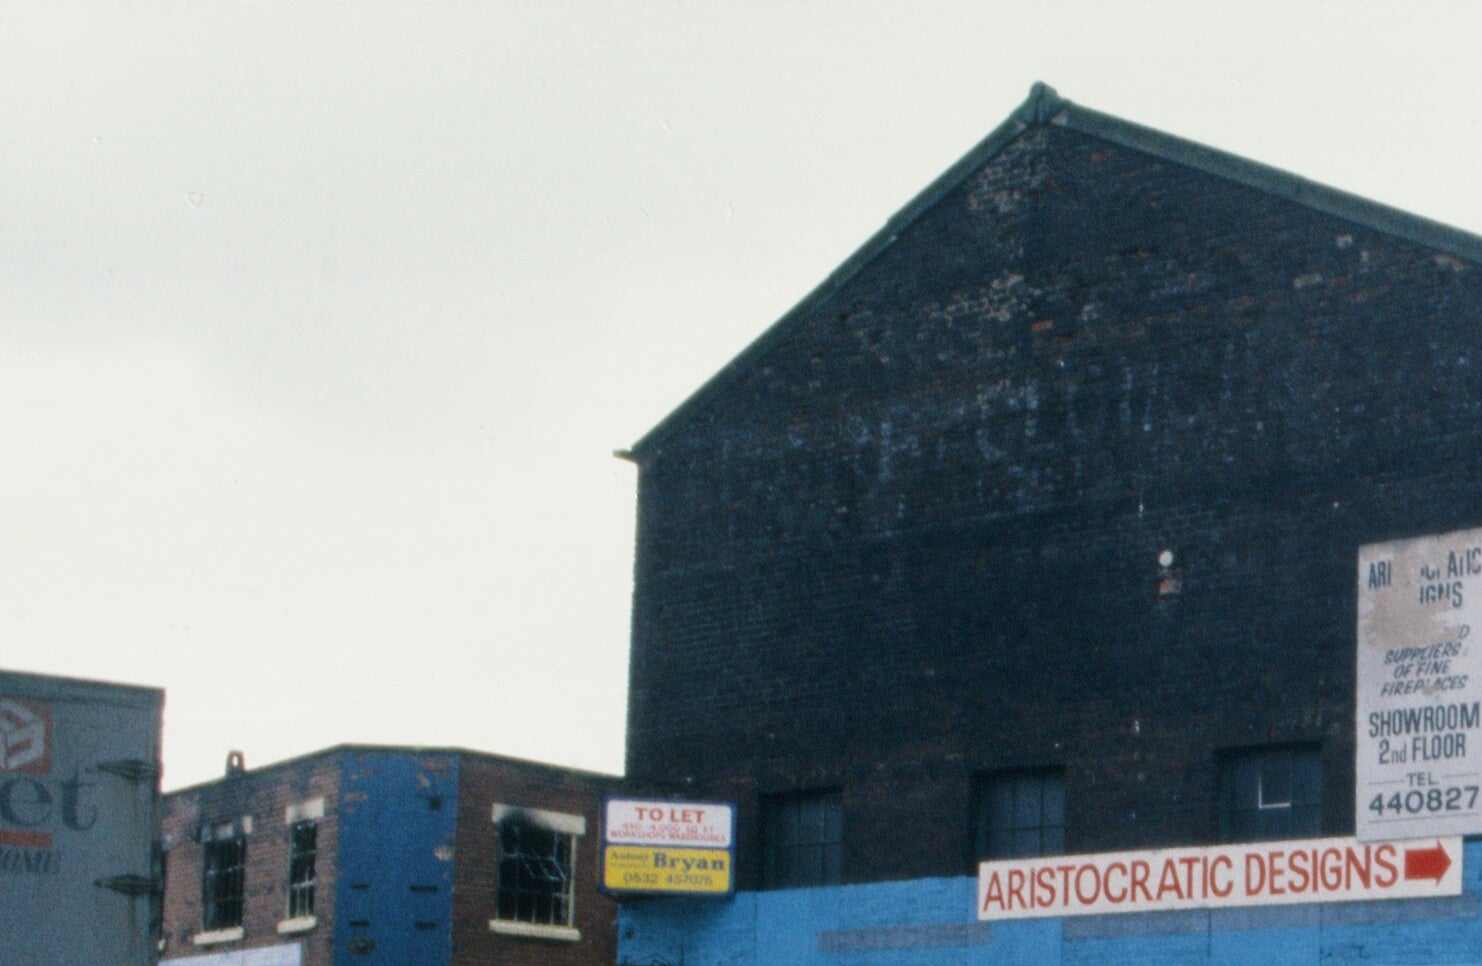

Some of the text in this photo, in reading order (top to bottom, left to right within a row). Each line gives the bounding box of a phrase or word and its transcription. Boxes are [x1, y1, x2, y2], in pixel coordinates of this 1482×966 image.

[1384, 642, 1462, 665] SUPPLIERS
[1394, 659, 1451, 679] OF FINE
[1380, 675, 1468, 697] FIREPACES
[1368, 702, 1480, 738] SHOWROOM
[1379, 733, 1466, 764] 2nd FLOOR
[1368, 785, 1480, 815] 440827
[635, 807, 706, 823] TO LET
[653, 852, 726, 873] Bryan
[623, 872, 658, 885] 0532
[983, 843, 1400, 912] ARISTOCRATIC DESIGNS
